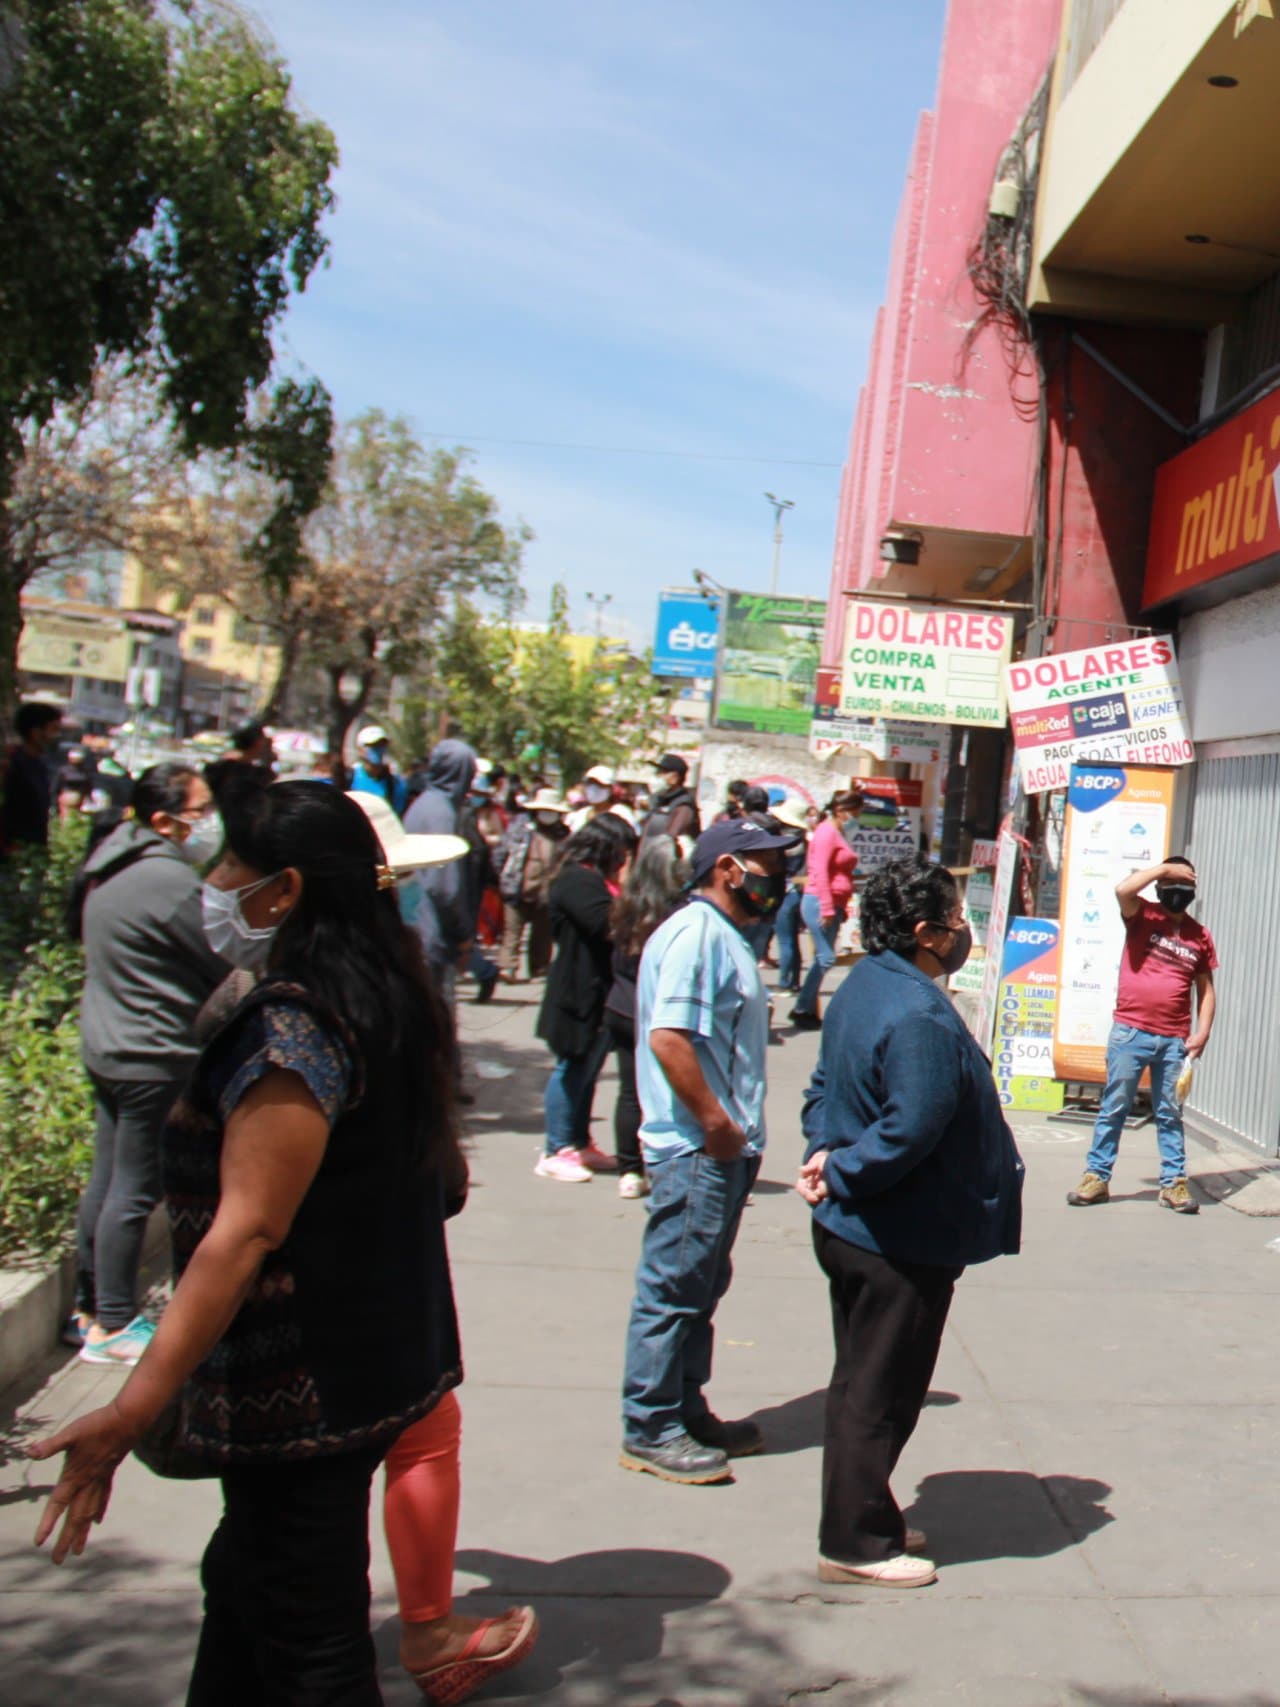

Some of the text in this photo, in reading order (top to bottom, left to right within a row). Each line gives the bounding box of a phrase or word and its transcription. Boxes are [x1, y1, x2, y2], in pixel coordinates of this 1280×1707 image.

[855, 606, 1005, 651] DOLARES
[850, 648, 936, 669] COMPRA
[1009, 640, 1173, 692] DOLARES
[853, 672, 926, 693] VENTA
[1047, 672, 1143, 699] AGENTE
[845, 696, 882, 711] EUROS
[891, 700, 946, 716] CHILENOS
[955, 705, 1000, 721] BOLIVIA
[1089, 700, 1126, 720] caja
[1133, 700, 1182, 722] KASNET
[1028, 764, 1068, 790] AGUA
[1081, 775, 1113, 791] BCP
[852, 833, 915, 845] AGUA
[1015, 931, 1048, 945] BCP
[1027, 970, 1056, 985] Agen
